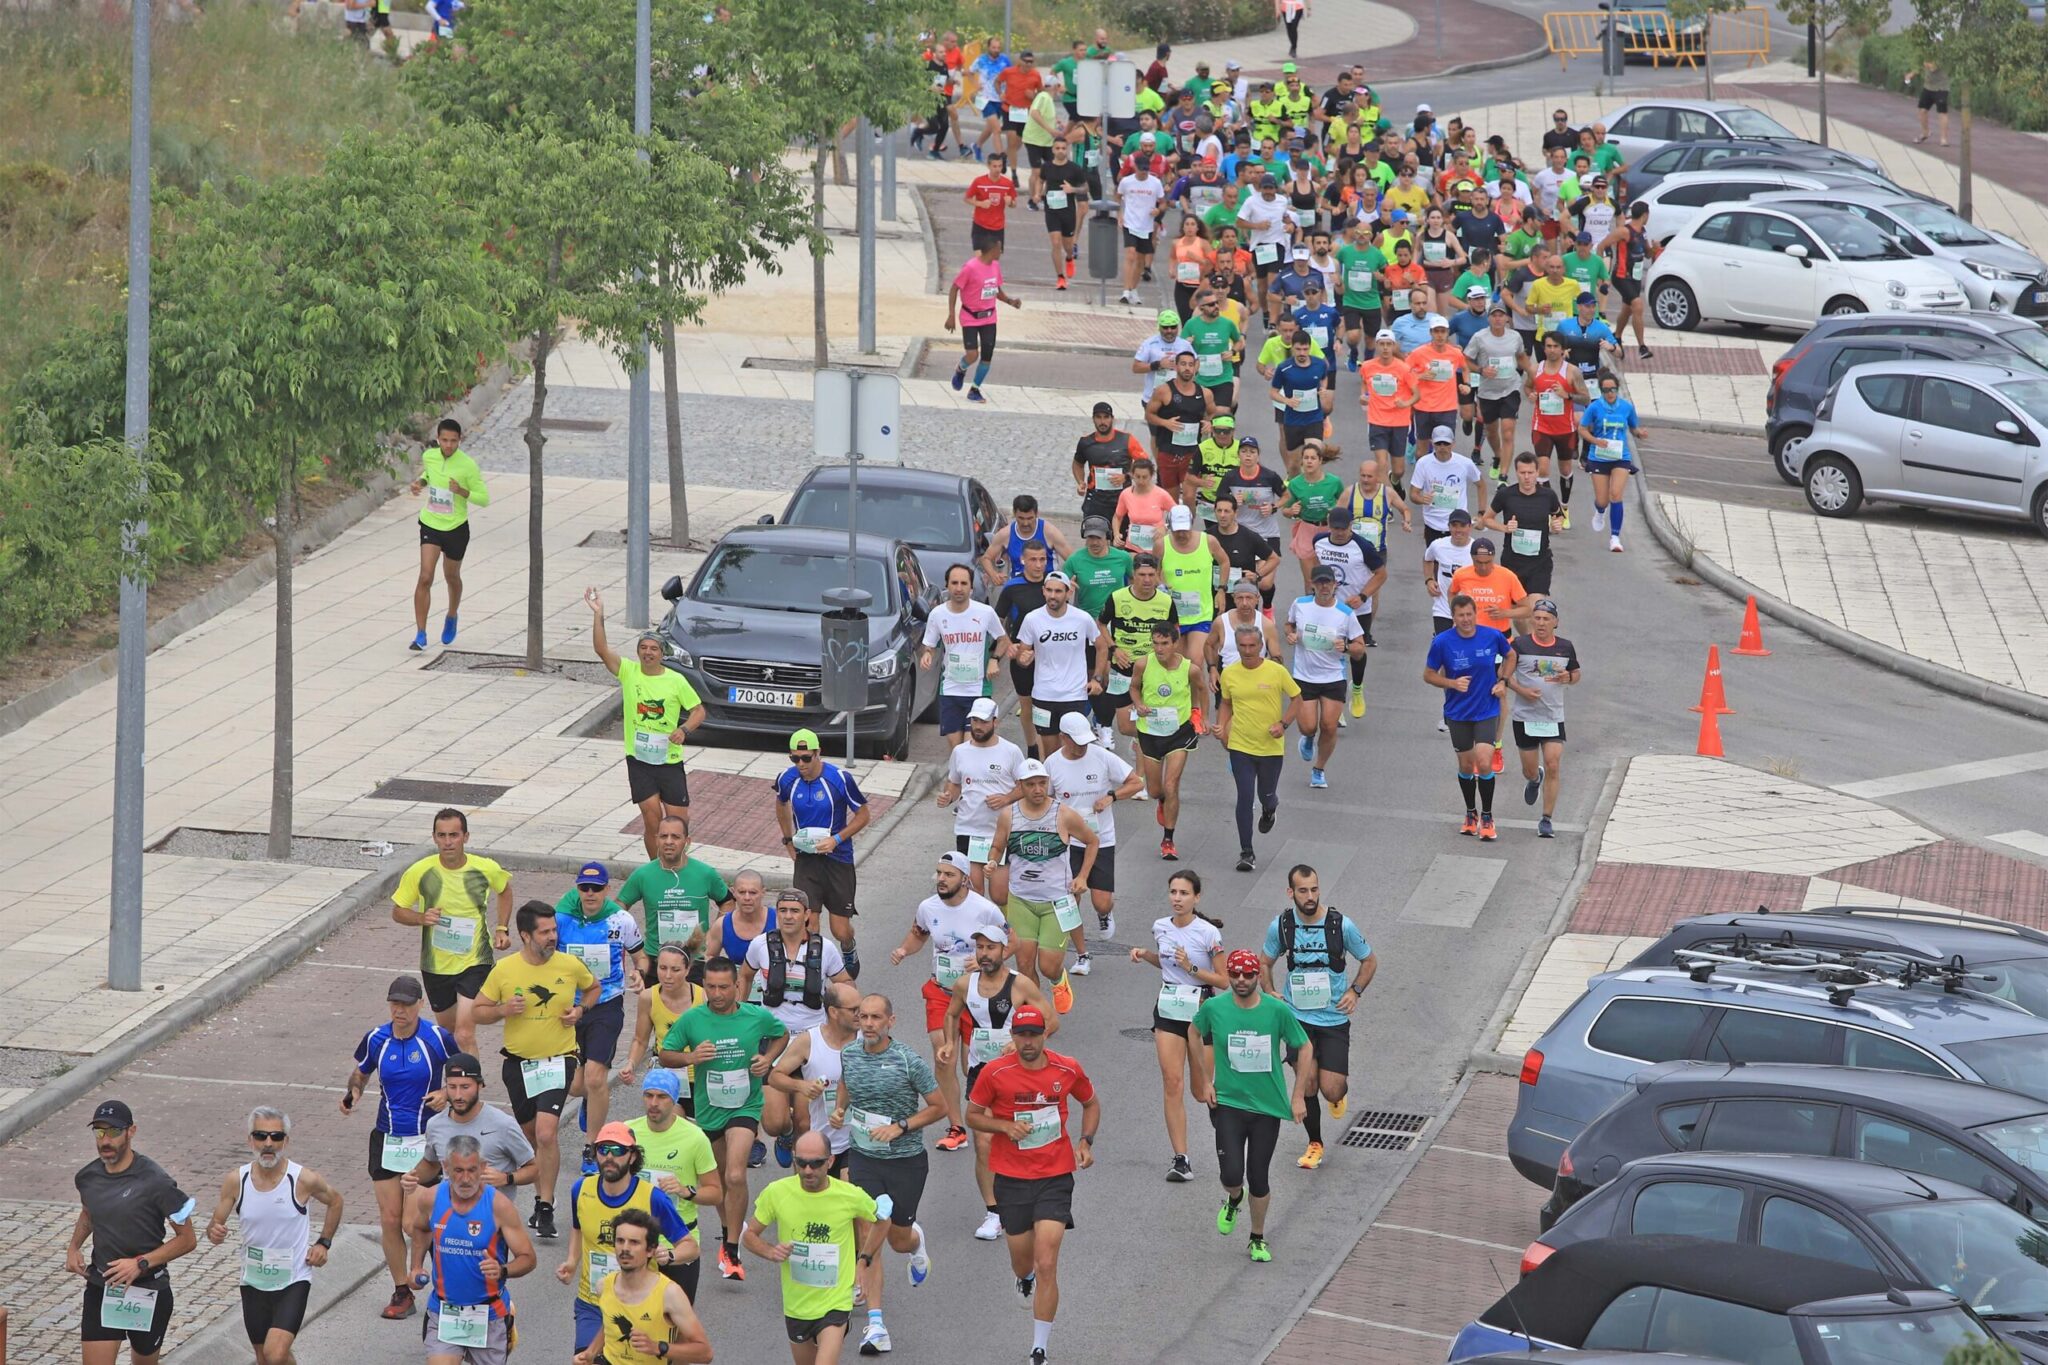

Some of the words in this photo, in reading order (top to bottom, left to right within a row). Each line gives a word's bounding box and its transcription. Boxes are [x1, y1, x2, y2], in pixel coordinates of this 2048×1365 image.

[668, 922, 689, 933] 279
[447, 929, 461, 940] 56
[607, 929, 621, 939] 29
[1301, 985, 1320, 996] 369
[1171, 995, 1185, 1007] 35
[1240, 1048, 1261, 1059] 497
[721, 1084, 737, 1096] 66
[255, 1263, 280, 1276] 365
[801, 1258, 826, 1272] 416
[114, 1299, 142, 1315] 246
[454, 1318, 475, 1332] 175
